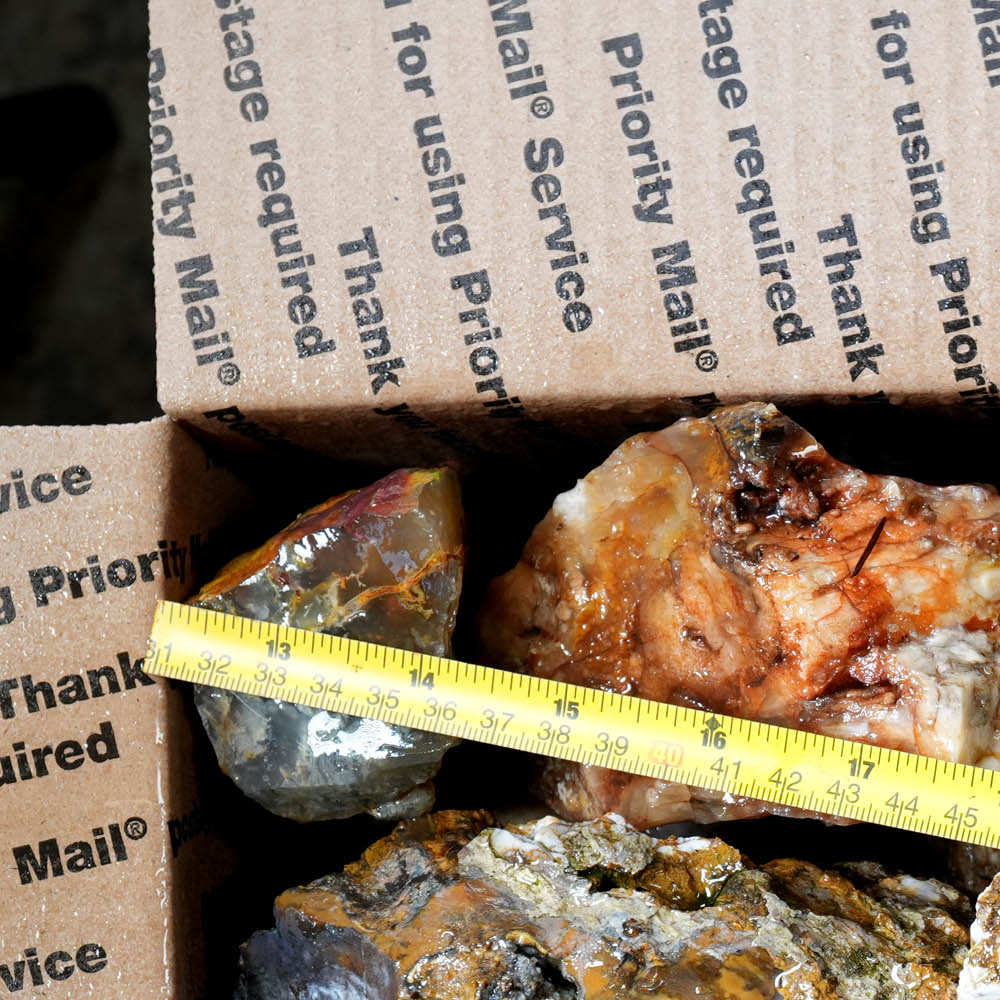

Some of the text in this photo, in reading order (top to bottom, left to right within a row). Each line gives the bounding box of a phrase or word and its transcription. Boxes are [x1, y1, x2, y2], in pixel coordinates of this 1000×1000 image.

[391, 21, 436, 98] for
[869, 8, 915, 86] for
[892, 101, 950, 246] using
[249, 139, 336, 359] required
[413, 114, 472, 258] using
[524, 137, 594, 334] Service
[601, 32, 673, 225] Priority
[651, 239, 718, 373] Mail®
[727, 124, 815, 347] required
[174, 253, 241, 387] Mail®
[337, 226, 406, 395] Thank
[816, 213, 886, 382] Thank
[0, 651, 155, 719] Thank
[197, 651, 231, 674] 32
[254, 663, 288, 686] 33
[310, 675, 343, 698] 34
[366, 685, 401, 709] 35
[423, 697, 458, 722] 36
[480, 709, 515, 731] 37
[537, 721, 571, 744] 38
[595, 732, 629, 756] 39
[710, 757, 742, 780] 41
[769, 768, 803, 792] 42
[827, 780, 861, 803] 43
[885, 792, 919, 815] 44
[944, 804, 979, 828] 45
[266, 639, 291, 660] 13
[409, 668, 435, 690] 14
[553, 698, 580, 720] 15
[700, 728, 727, 750] 16
[848, 758, 876, 780] 17
[12, 816, 147, 885] Mail®
